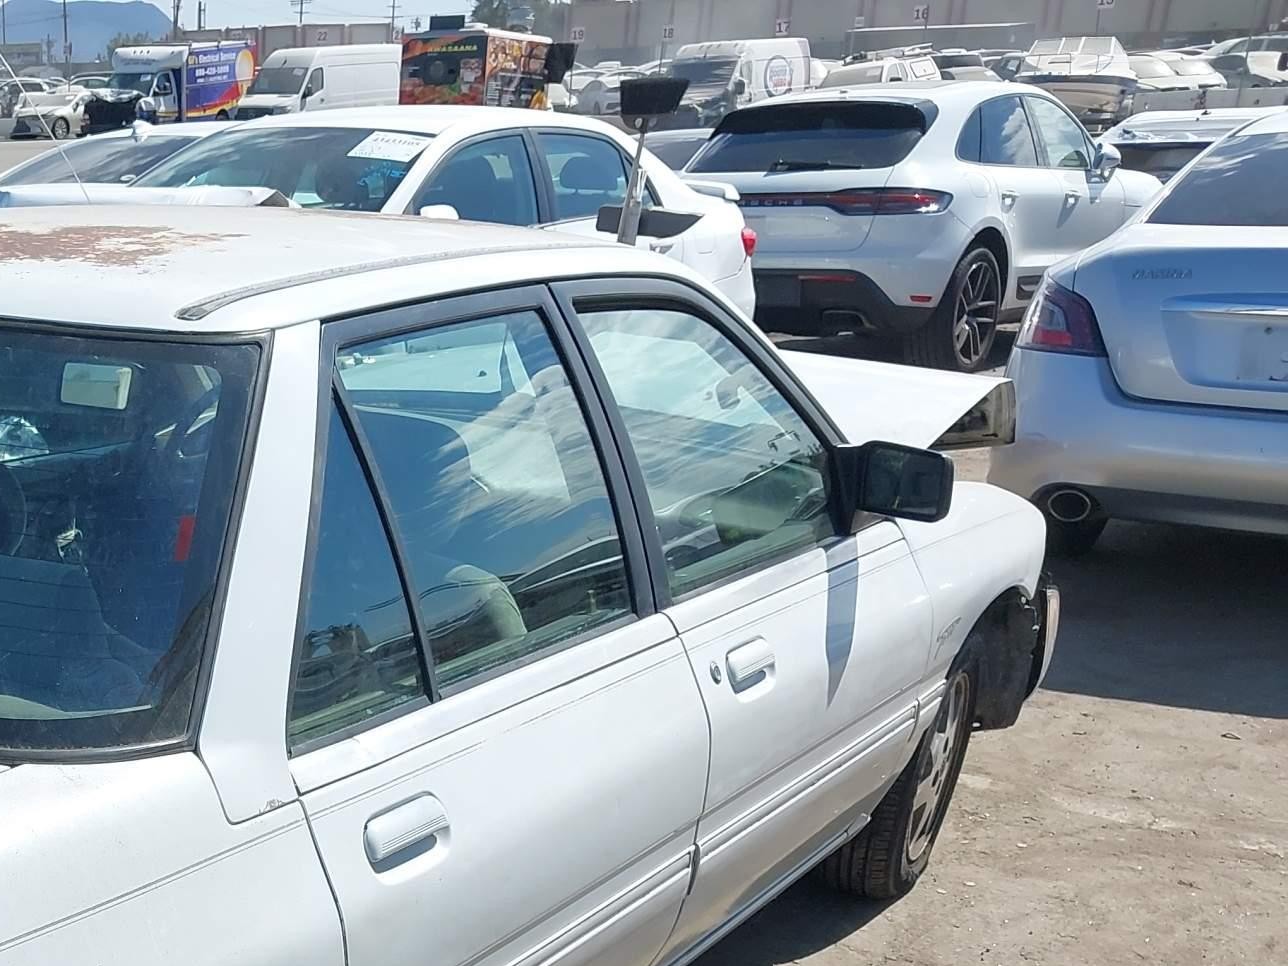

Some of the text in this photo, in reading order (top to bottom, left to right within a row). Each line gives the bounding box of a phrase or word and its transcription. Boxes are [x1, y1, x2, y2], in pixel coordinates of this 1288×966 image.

[914, 8, 928, 20] 16
[776, 22, 790, 33] 17
[317, 31, 328, 41] 22
[573, 30, 584, 40] 19
